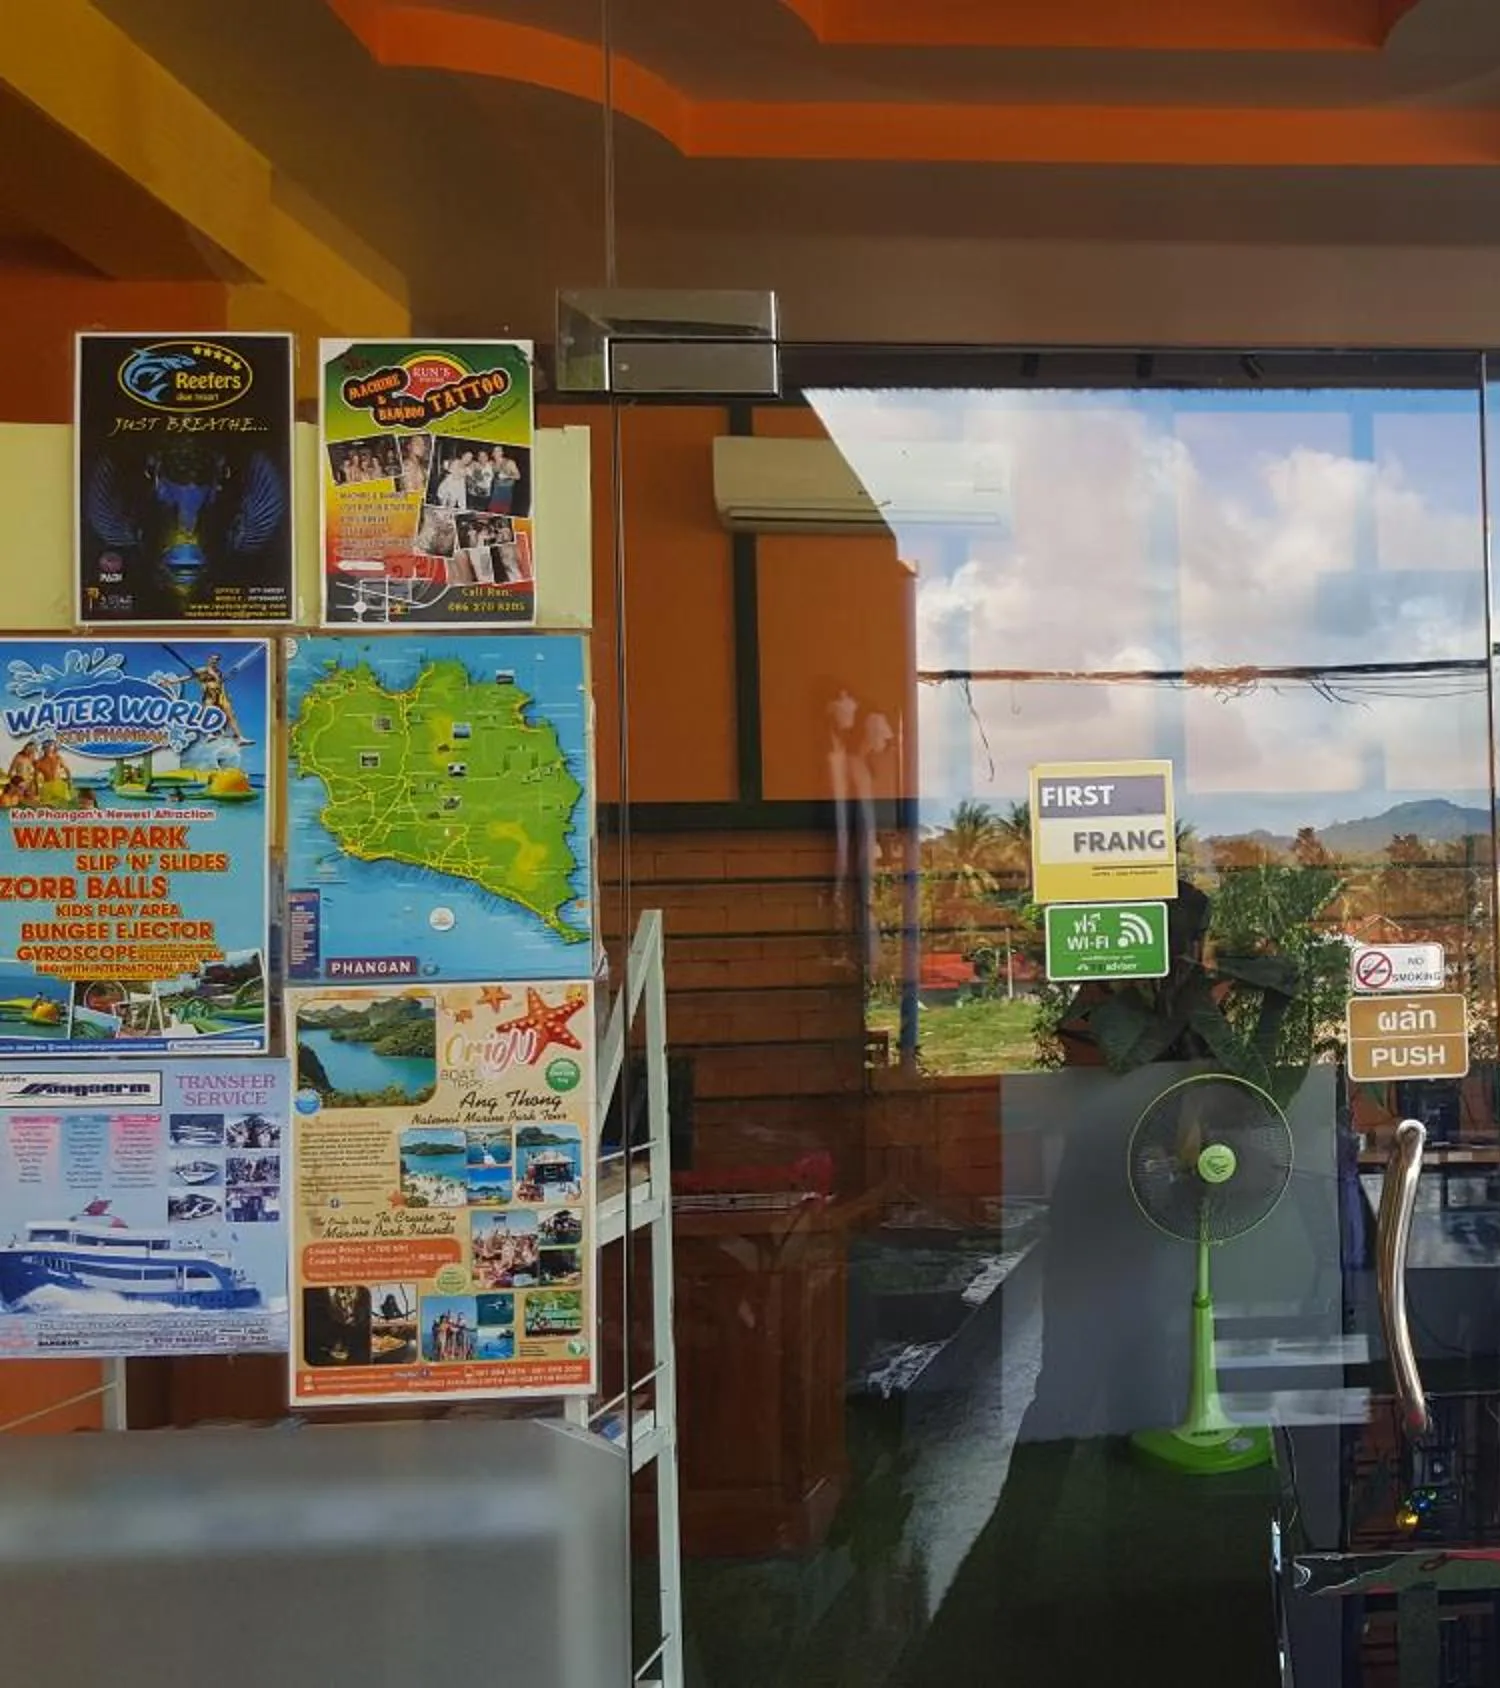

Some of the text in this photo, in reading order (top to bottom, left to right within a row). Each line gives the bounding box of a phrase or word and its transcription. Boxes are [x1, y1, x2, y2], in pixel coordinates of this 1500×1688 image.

[176, 371, 241, 389] Reefers
[427, 373, 505, 413] TATTOO
[107, 417, 160, 437] JUST
[5, 696, 227, 733] WATER WORLD
[1041, 785, 1115, 807] FIRST
[107, 810, 150, 819] Newest
[154, 810, 214, 819] Attraction
[12, 825, 190, 849] WATERPARK
[1073, 829, 1165, 853] FRANG
[76, 854, 120, 872] SLIP
[159, 853, 228, 872] SLIDES
[0, 876, 169, 899] ZORB BALLS
[56, 904, 181, 917] KIDS PLAY AREA
[21, 921, 213, 940] BUNGEE EJECTOR
[1074, 913, 1100, 934] ฟรี
[1067, 935, 1109, 950] WI-FI
[16, 945, 139, 961] GYROSCOPE
[1407, 957, 1425, 965] NO
[331, 960, 412, 974] PHANGAN
[1392, 972, 1441, 982] SMOKING
[1378, 1003, 1437, 1031] ผลัก
[1371, 1044, 1446, 1068] PUSH
[176, 1074, 276, 1090] TRANSFER
[184, 1091, 267, 1106] SERVICE
[459, 1089, 562, 1114] Ang Thong
